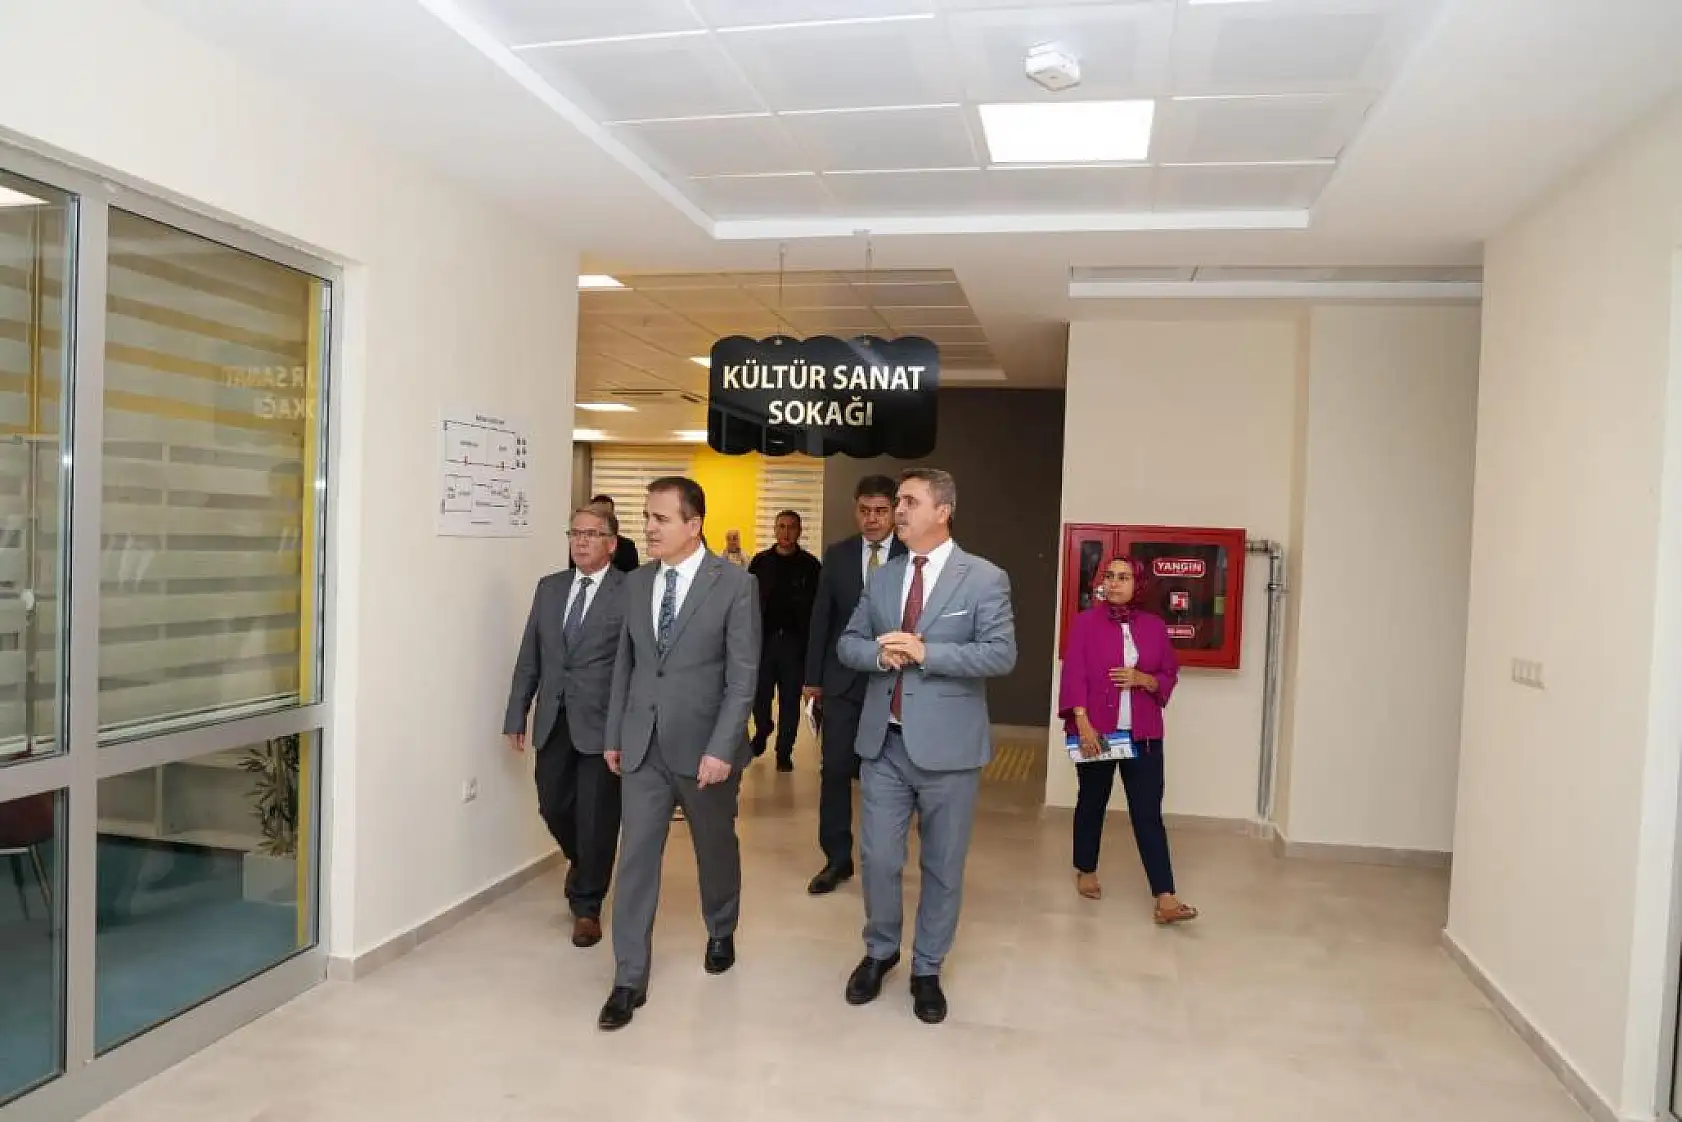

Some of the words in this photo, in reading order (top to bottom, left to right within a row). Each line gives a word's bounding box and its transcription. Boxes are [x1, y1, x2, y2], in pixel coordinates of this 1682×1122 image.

[722, 359, 826, 390] KÜLTÜR
[833, 365, 926, 390] SANAT
[768, 395, 873, 426] SOKAĞI
